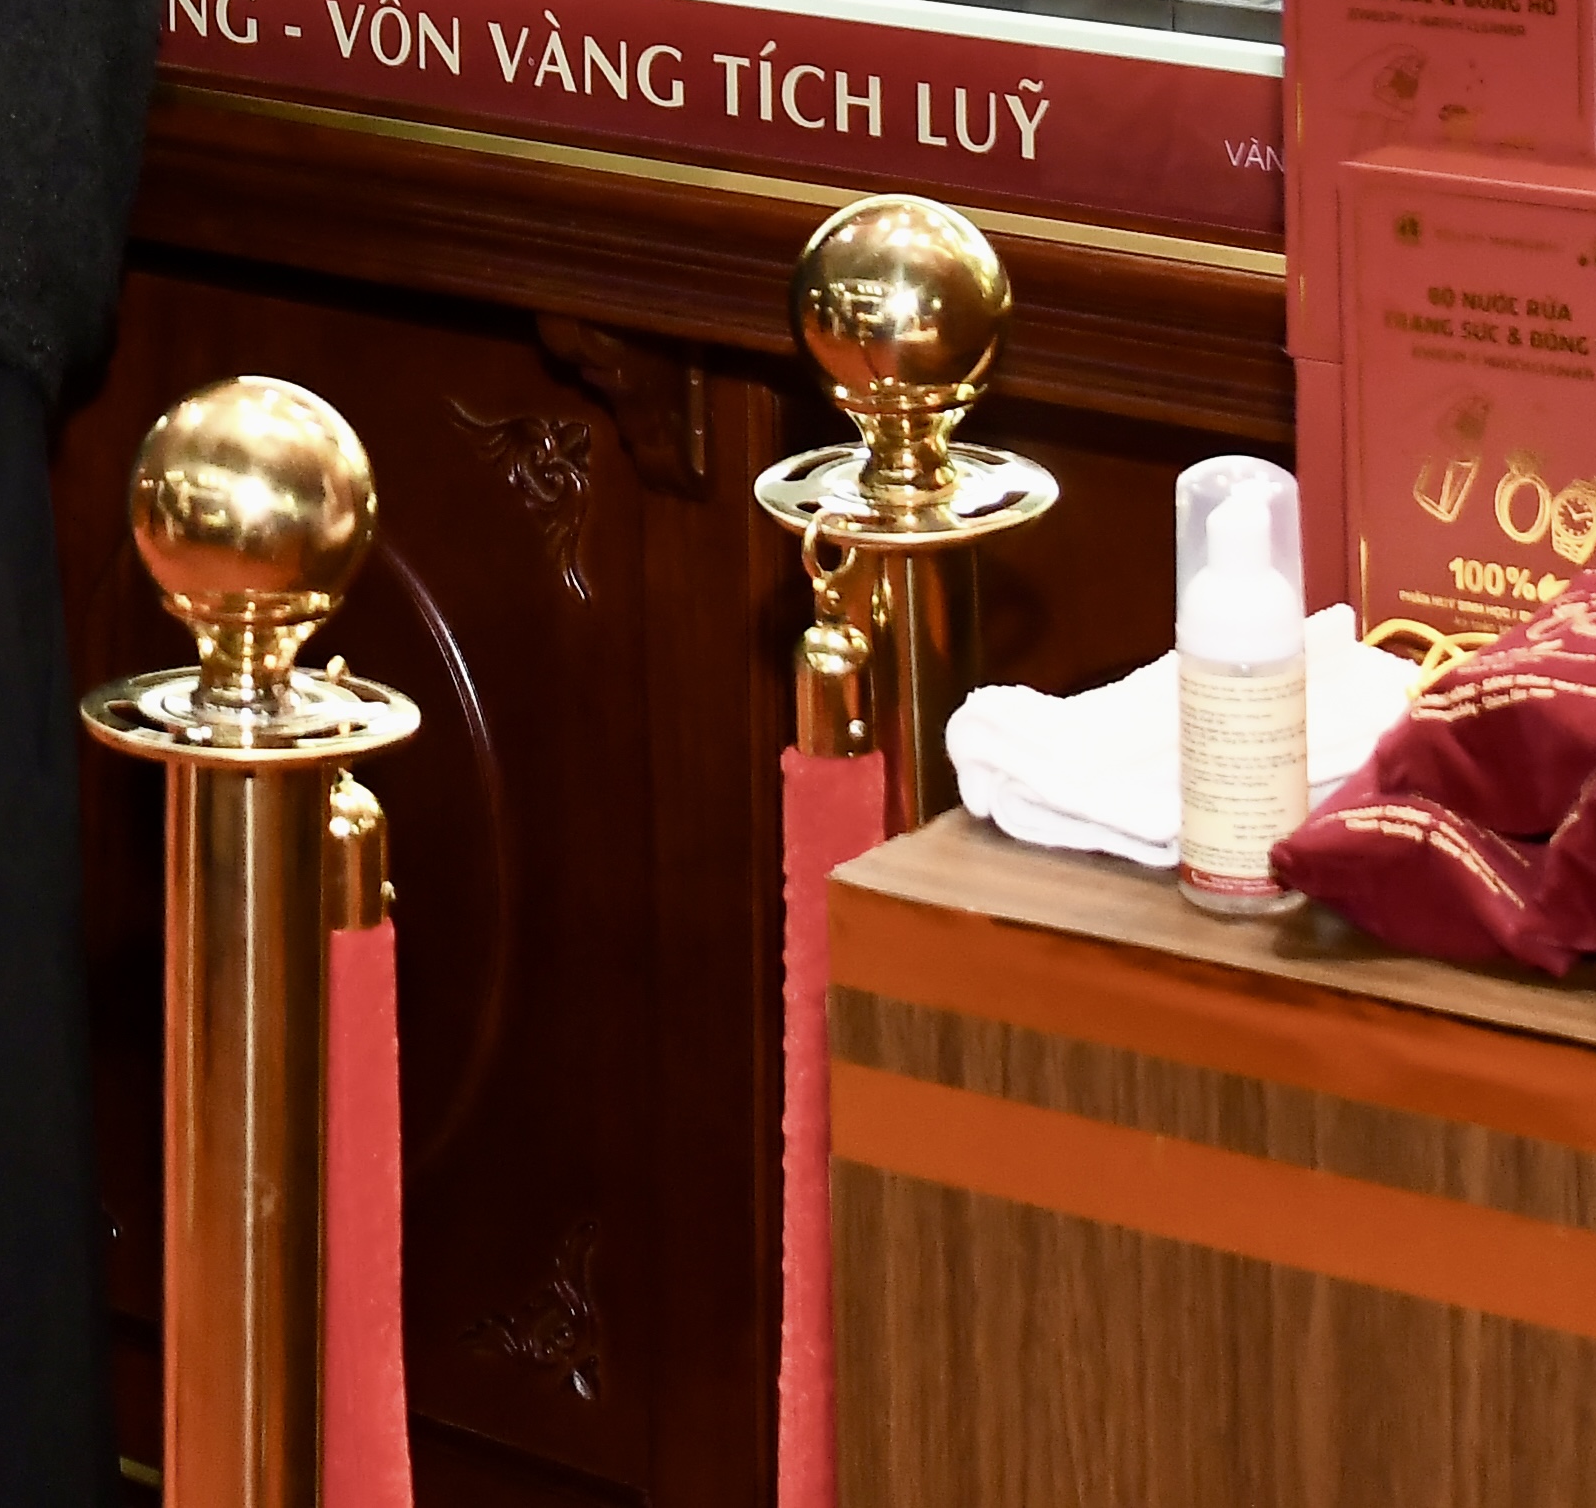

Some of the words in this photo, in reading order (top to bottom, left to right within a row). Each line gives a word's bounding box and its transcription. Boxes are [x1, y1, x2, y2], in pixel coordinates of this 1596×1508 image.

[487, 9, 686, 109] VÀNG
[712, 39, 883, 139] TÍCH
[914, 78, 1052, 162] LUỸ
[1224, 135, 1284, 175] VÀN
[1447, 555, 1538, 602] 100%
